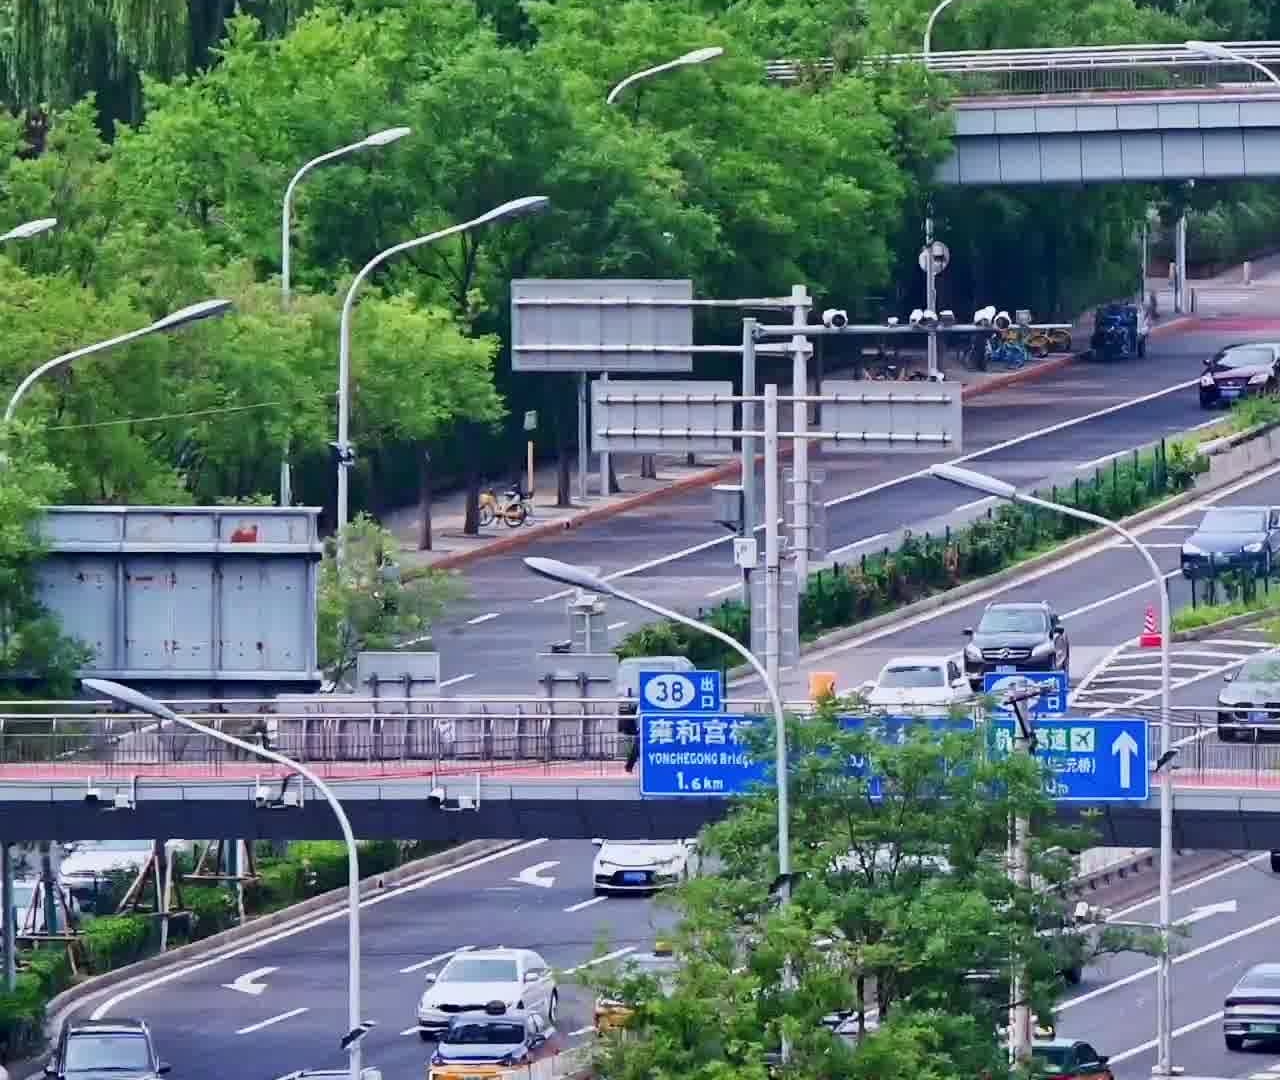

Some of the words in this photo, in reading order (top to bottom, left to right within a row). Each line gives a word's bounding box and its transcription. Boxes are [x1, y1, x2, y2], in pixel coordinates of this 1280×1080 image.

[656, 681, 683, 702] 38
[700, 676, 714, 709] 出口
[648, 751, 718, 765] YONGHEGONG
[676, 770, 724, 790] 1.6km
